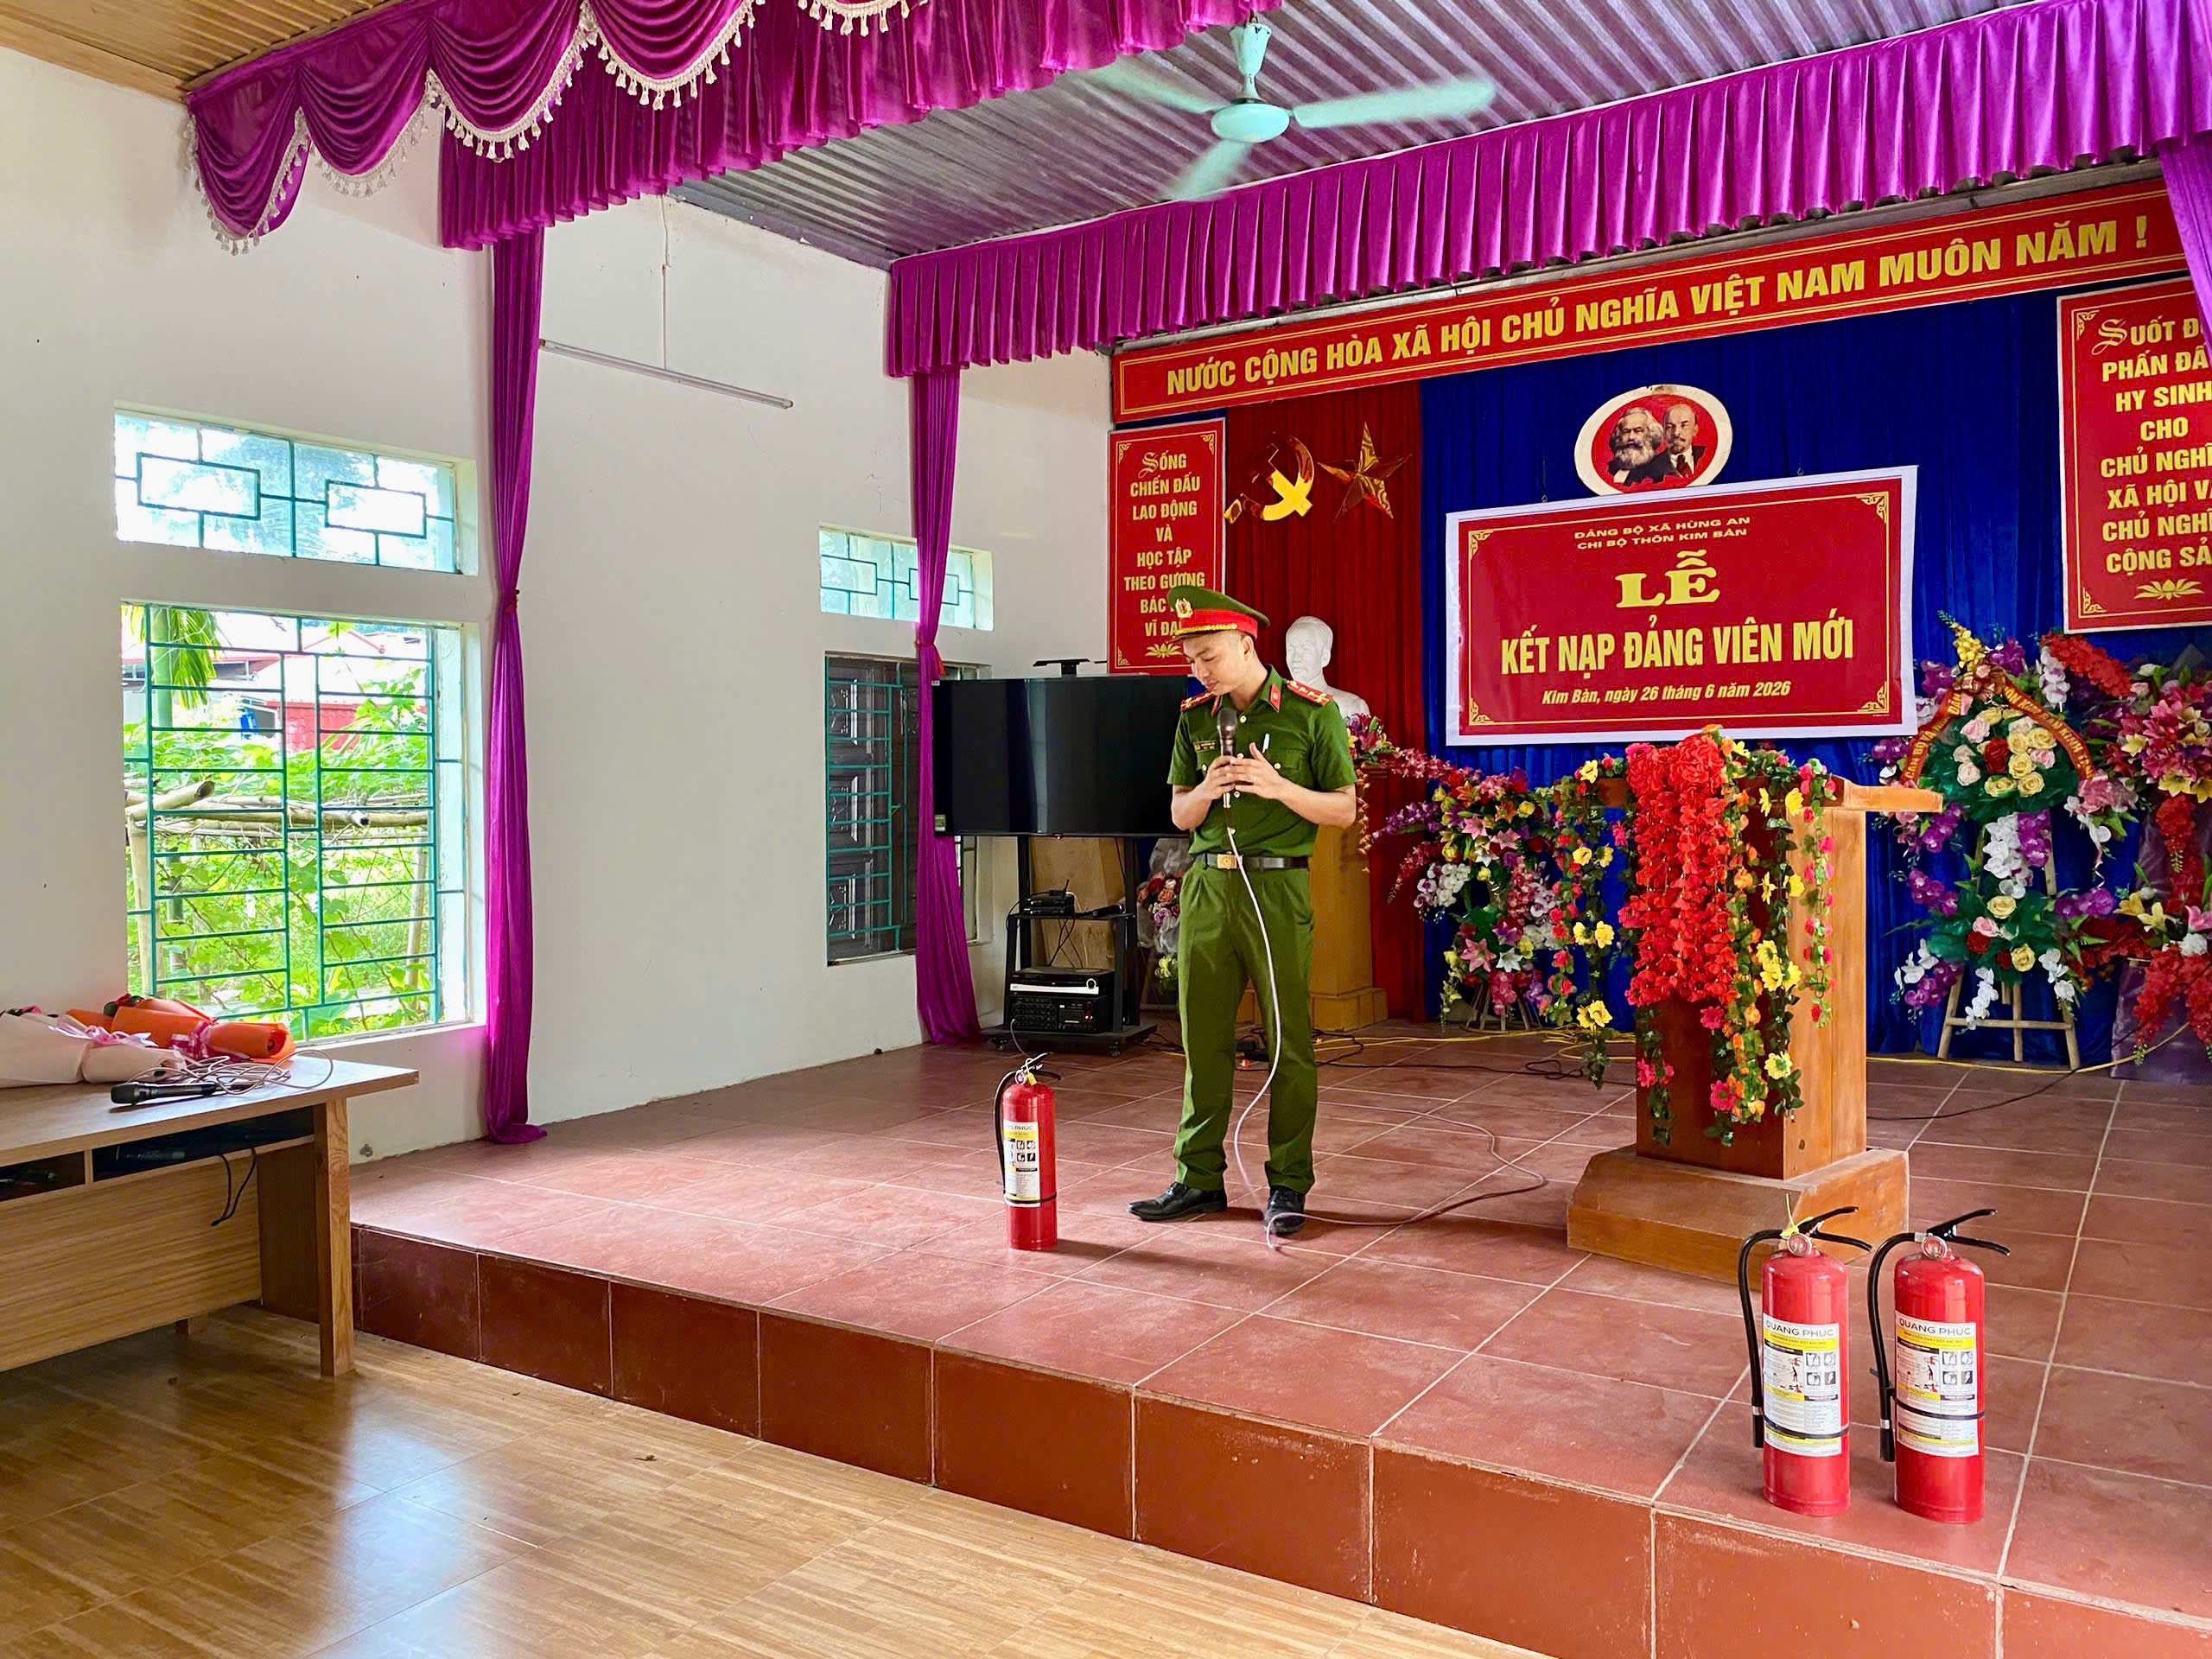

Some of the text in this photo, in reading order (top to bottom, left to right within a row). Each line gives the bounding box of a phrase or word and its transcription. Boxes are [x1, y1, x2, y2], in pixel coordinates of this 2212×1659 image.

[1168, 215, 2148, 395] NƯỚC CỘNG HÒA XÃ HỘI CHỦ NGHĨA VIỆT NAM MUÔN NĂM !
[2091, 315, 2175, 355] SUỐT
[2101, 341, 2209, 382] PHẤN ĐẤ
[2116, 381, 2212, 412] HY SINH
[2140, 417, 2188, 441] CHO
[1138, 451, 1187, 478] SỐNG
[2101, 446, 2147, 477] CHỦ
[1130, 472, 1199, 498] CHIẾN ĐẤU
[2107, 480, 2212, 509] XÃ HỘI V
[1134, 499, 1197, 520] LAO ĐỘNG
[1156, 524, 1173, 542] VÀ
[1624, 525, 1643, 535] BỘ
[1649, 523, 1670, 532] XÃ
[2103, 511, 2149, 541] CHỦ
[1632, 535, 1674, 544] THÔN
[1137, 547, 1192, 569] HỌC TẬP
[2107, 537, 2212, 575] CỘNG SẢ
[1124, 575, 1155, 590] THEO
[1615, 550, 1719, 607] LỄ
[1141, 596, 1166, 613] BÁC
[1145, 620, 1182, 639] VĨ ĐẠ
[1502, 608, 1853, 679] KẾT NẠP ĐẢNG VIÊN MỚI
[1542, 690, 1568, 704] Kim
[1605, 687, 1638, 703] ngày
[1640, 686, 1659, 701] 26
[1662, 685, 1701, 700] tháng
[1705, 684, 1714, 698] 6
[1718, 683, 1750, 697] năm
[1753, 681, 1791, 696] 2026
[1765, 1319, 1800, 1336] QUANG
[1899, 1318, 1936, 1334] QUANG
